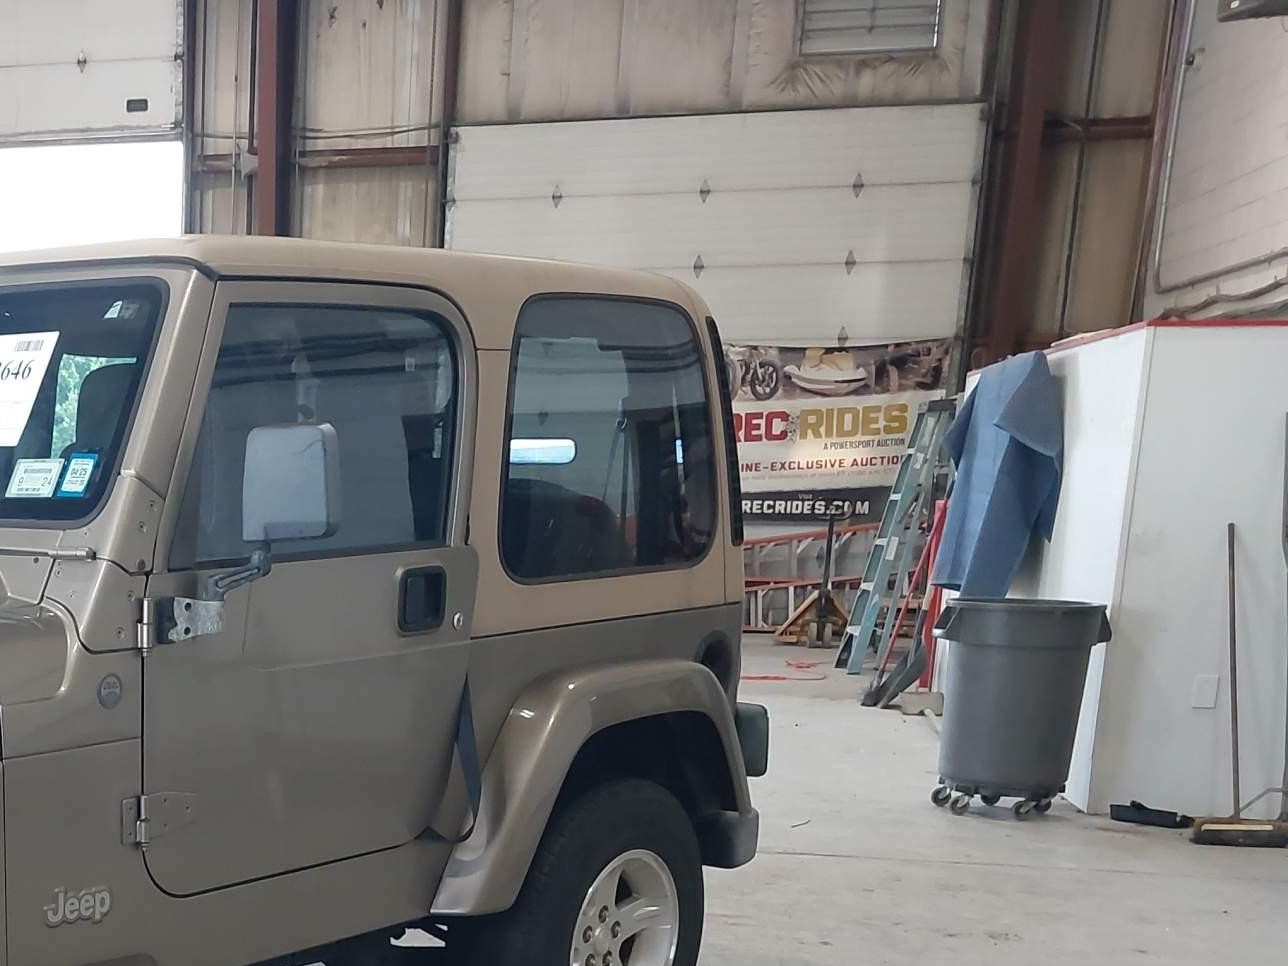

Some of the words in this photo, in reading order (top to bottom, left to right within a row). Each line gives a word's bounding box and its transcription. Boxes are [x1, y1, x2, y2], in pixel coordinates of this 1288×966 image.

[799, 403, 908, 440] RIDES
[824, 442, 829, 450] A
[830, 439, 875, 450] POWERSPORT
[877, 437, 905, 448] AUCTION
[45, 889, 111, 925] Jeep
